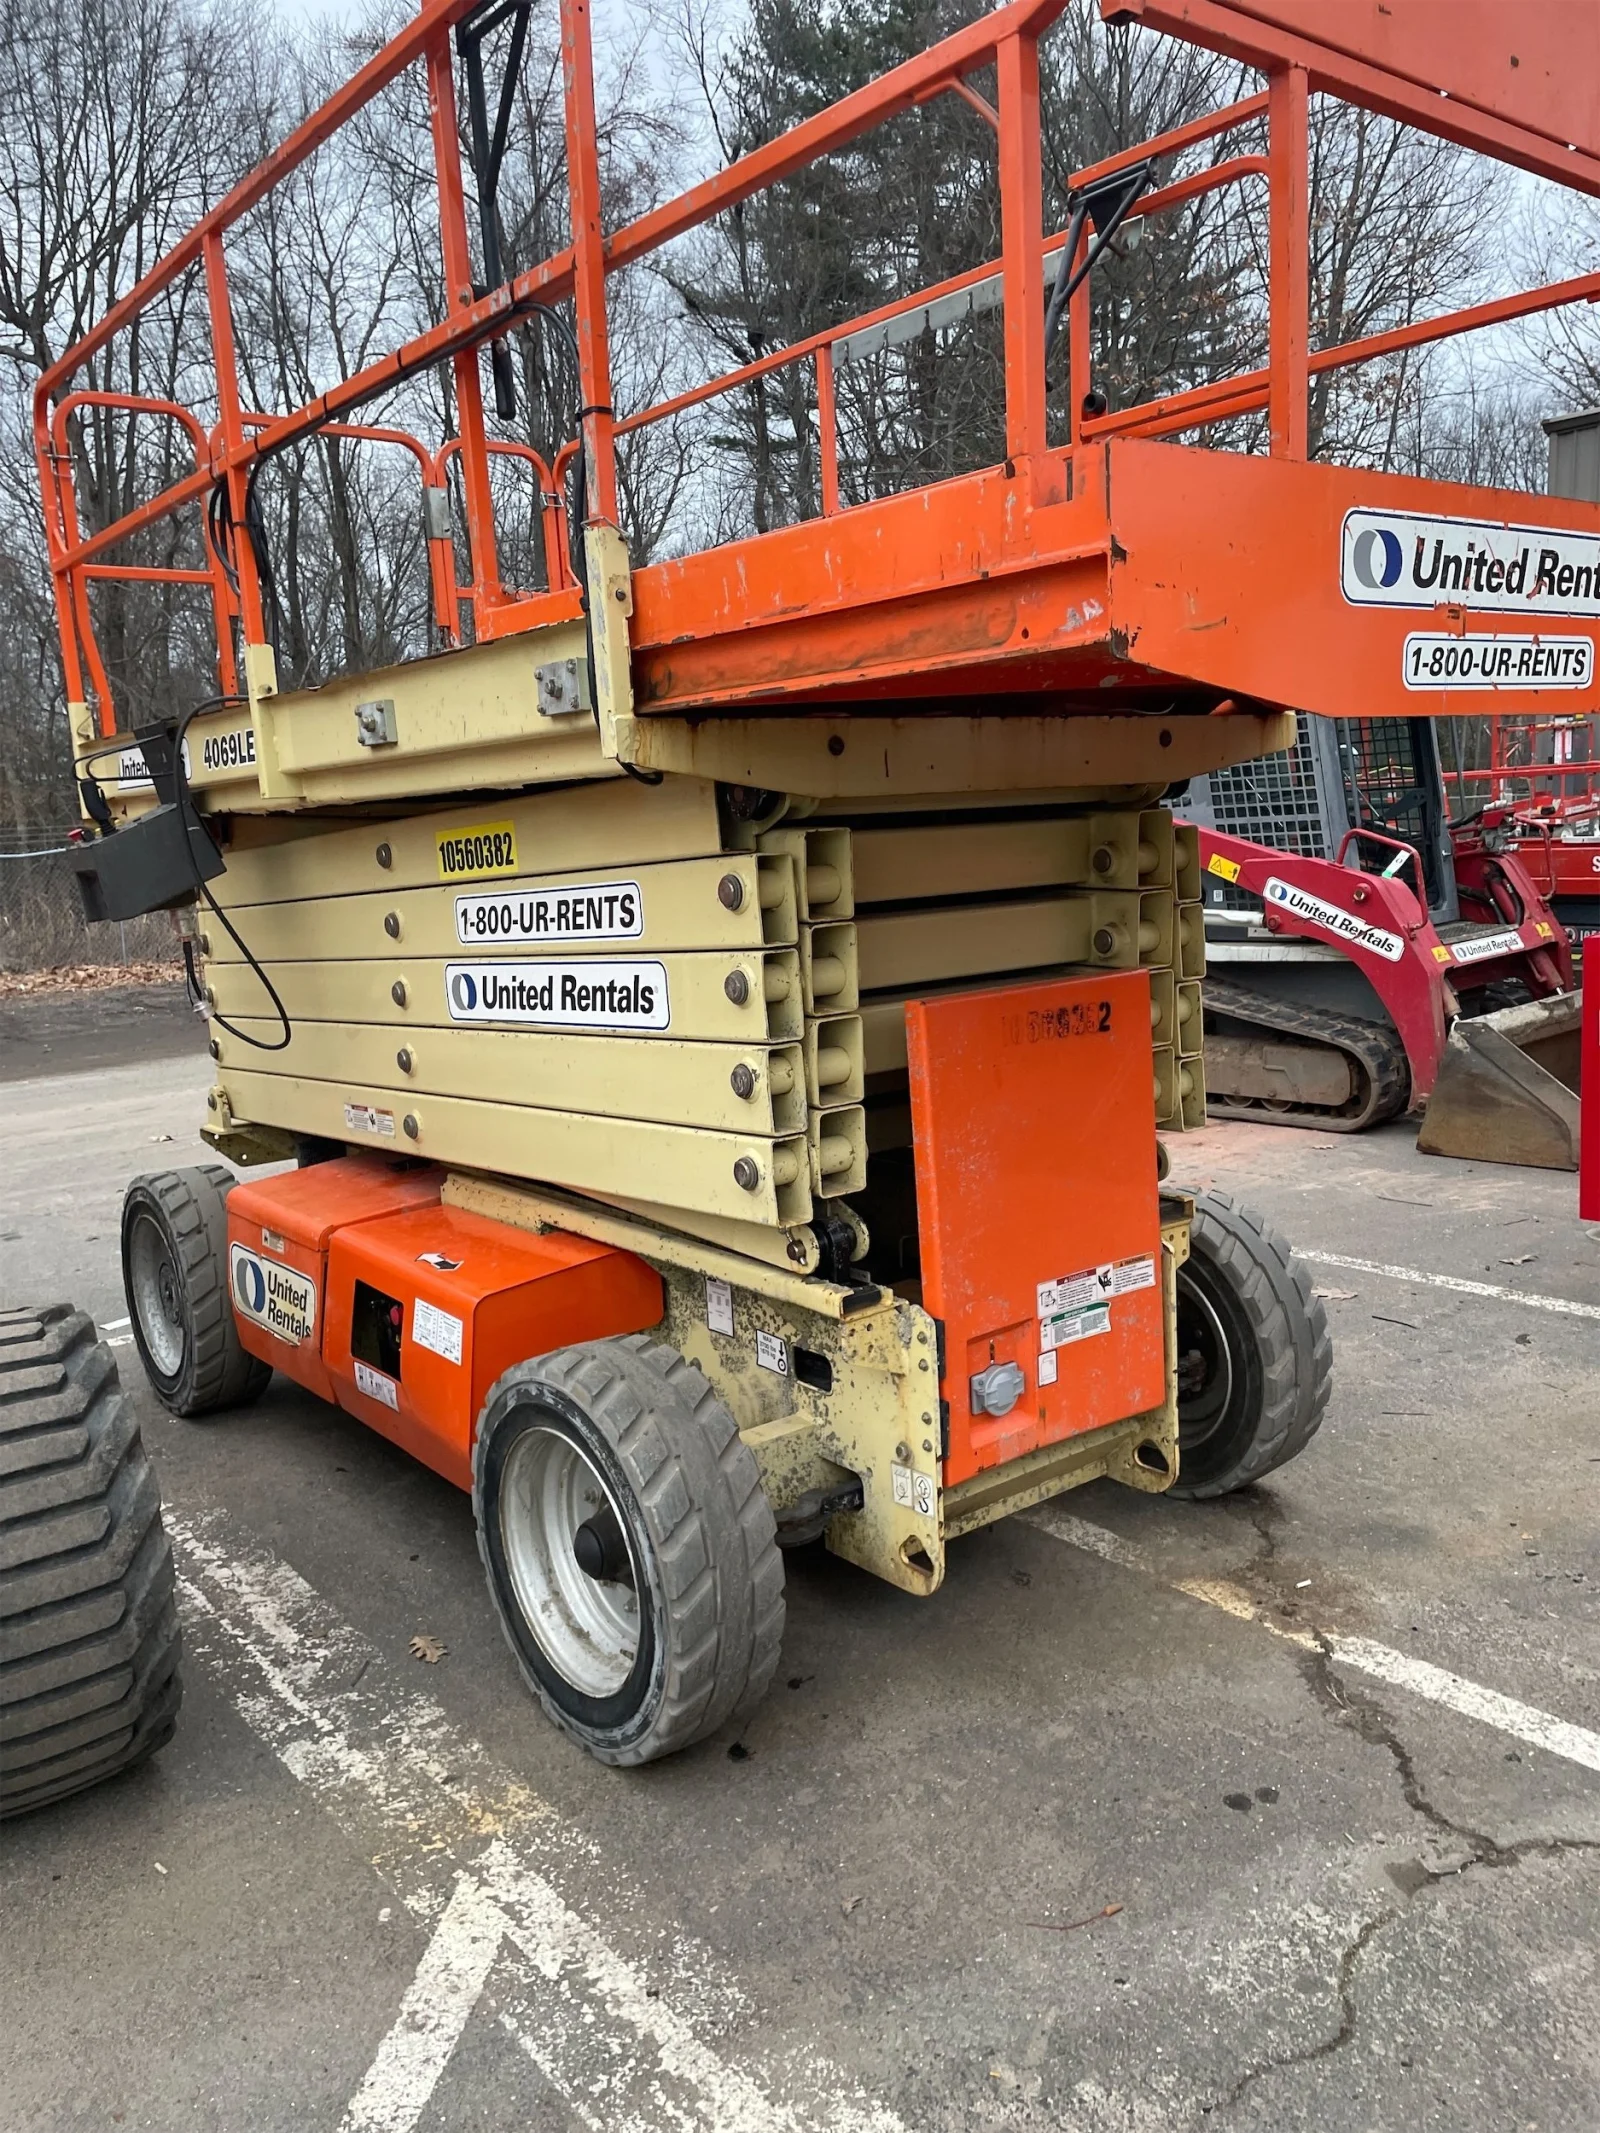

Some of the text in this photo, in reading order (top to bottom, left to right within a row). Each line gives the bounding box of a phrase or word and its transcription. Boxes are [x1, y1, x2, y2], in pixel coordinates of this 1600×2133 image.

[1412, 535, 1530, 595] United
[1411, 646, 1587, 677] 1-800-UR-RENTS
[203, 730, 256, 769] 4069LE
[438, 831, 514, 873] 10560382
[460, 893, 635, 936] 1-800-UR-RENTS
[1289, 893, 1395, 953] United Rentals
[1466, 937, 1519, 956] United Rentals
[482, 974, 654, 1014] United Rentals
[267, 1270, 309, 1313] United
[267, 1297, 312, 1339] Rentals
